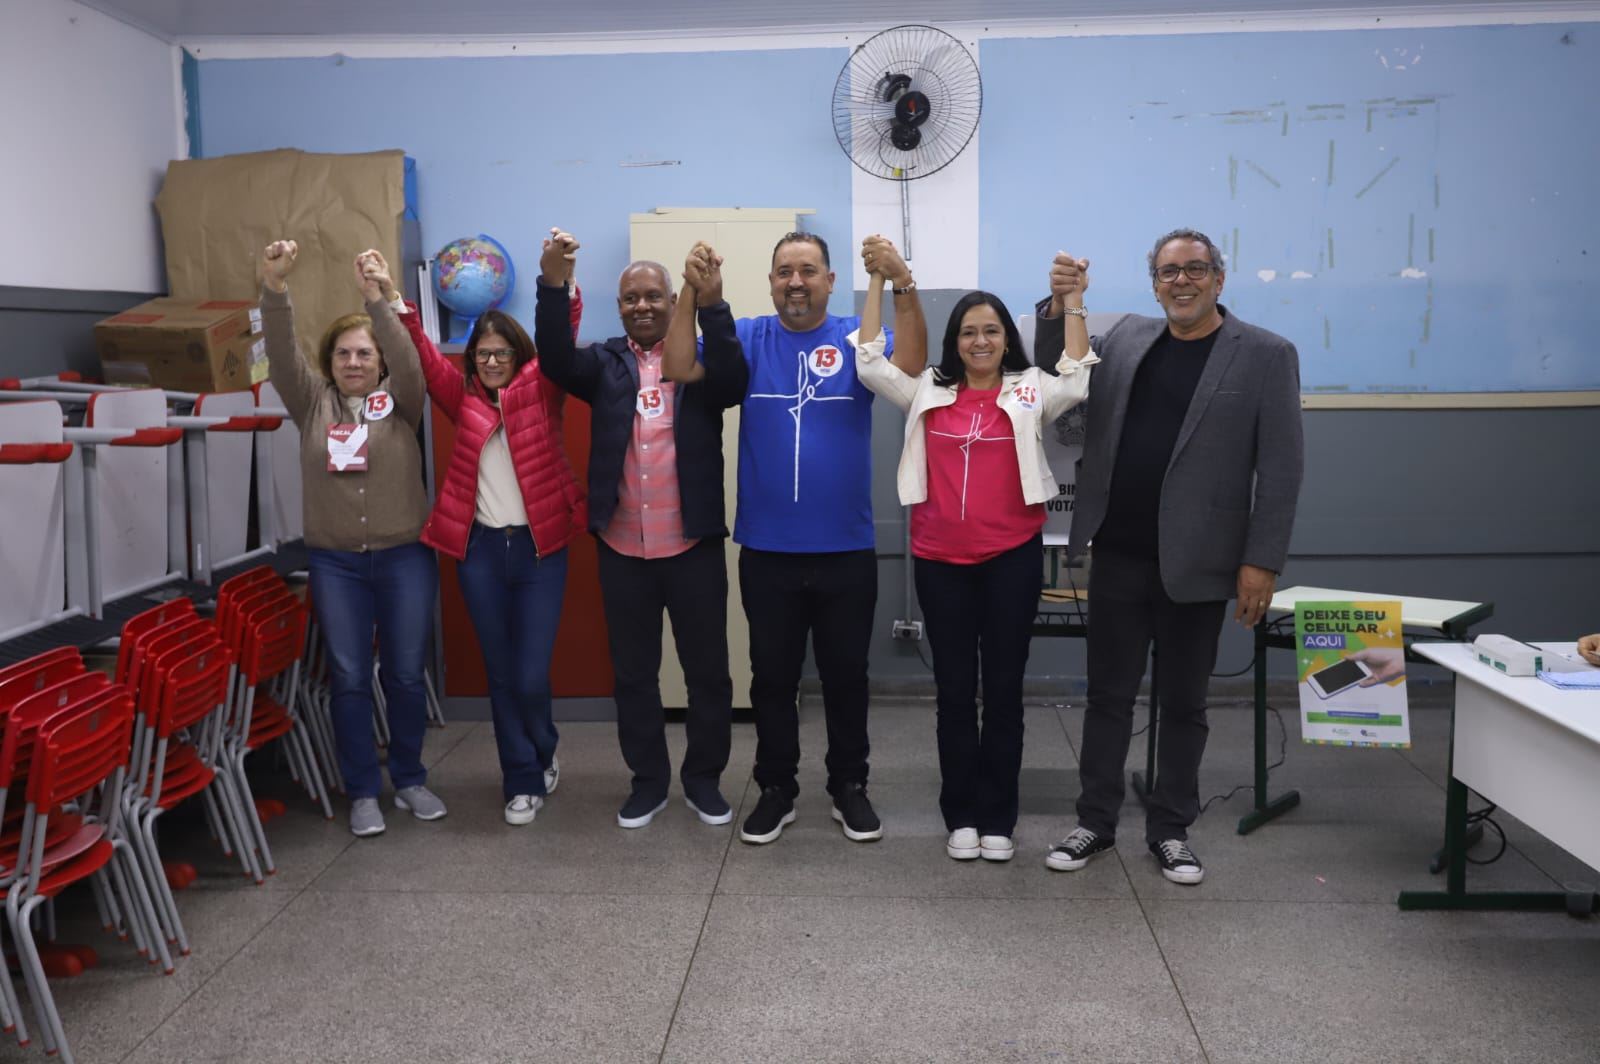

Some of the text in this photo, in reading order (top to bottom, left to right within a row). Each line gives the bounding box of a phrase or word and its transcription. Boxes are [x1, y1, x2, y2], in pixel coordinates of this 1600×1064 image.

[815, 348, 837, 367] 13
[367, 394, 388, 413] 13
[639, 389, 660, 410] 13
[1303, 610, 1386, 621] DEIXE SEU
[1304, 622, 1379, 633] CELULAR
[1304, 635, 1342, 647] AQUI
